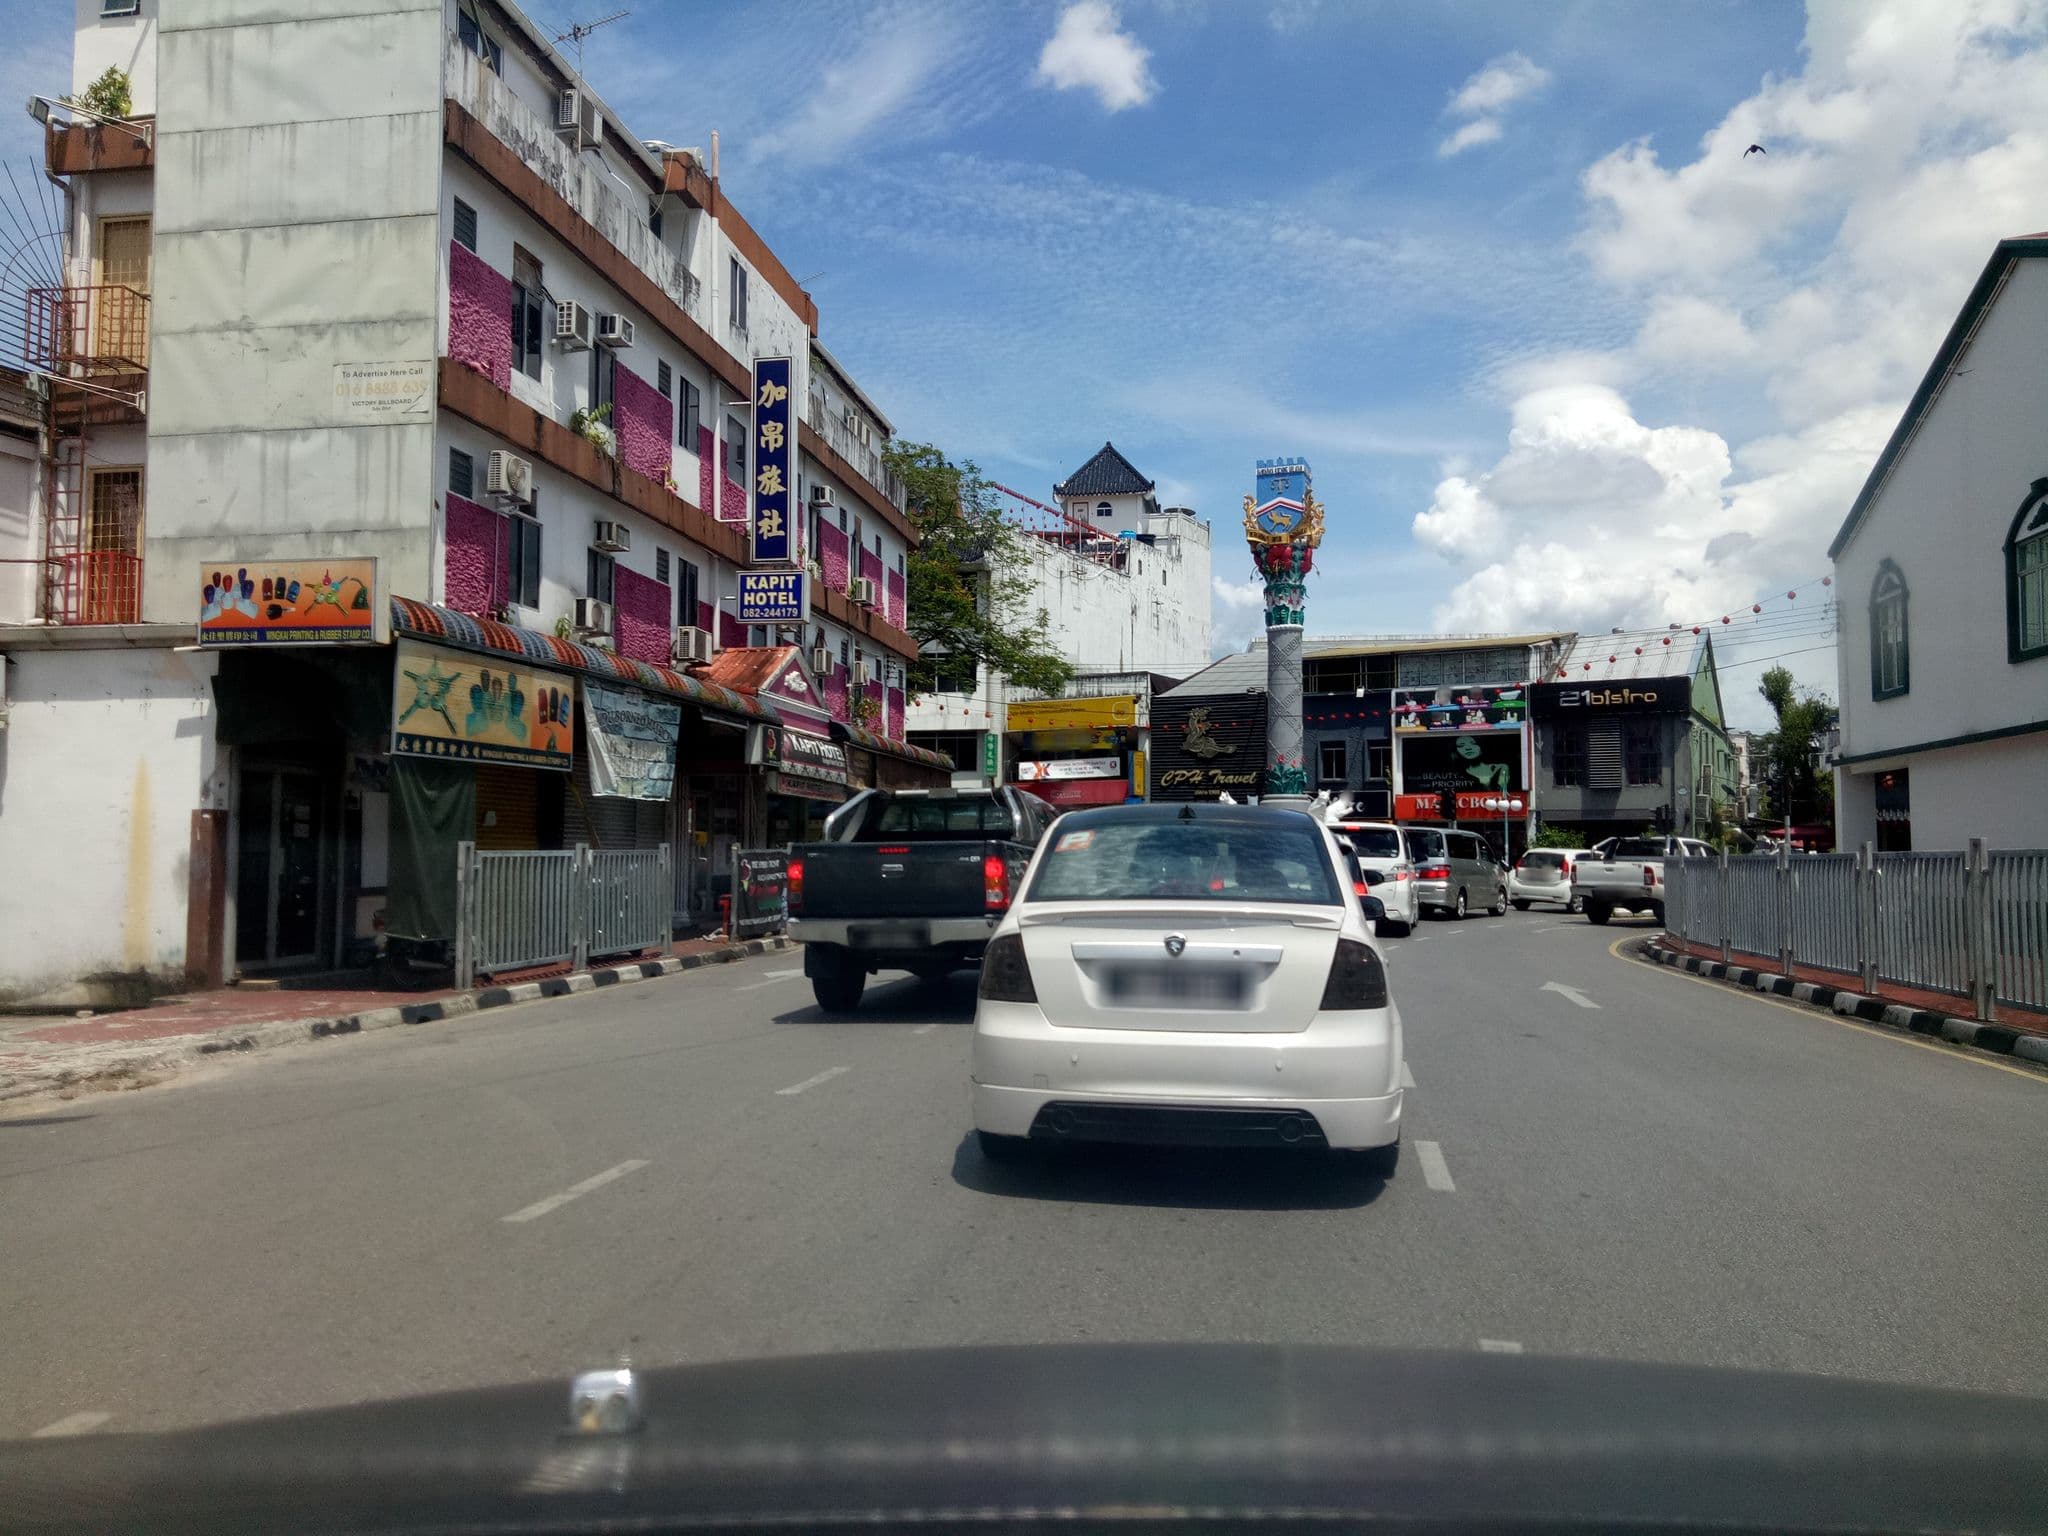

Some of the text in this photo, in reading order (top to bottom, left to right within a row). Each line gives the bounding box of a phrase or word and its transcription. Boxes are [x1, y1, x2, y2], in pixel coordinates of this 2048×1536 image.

[352, 370, 388, 378] Advertise
[746, 576, 796, 590] KAPIT
[743, 591, 797, 606] HOTEL
[742, 607, 798, 618] 082-244179
[787, 733, 846, 762] KAPIT HOTEL
[1161, 769, 1257, 787] CPH Travel
[1431, 780, 1475, 788] PRIORITY
[1063, 833, 1088, 848] P
